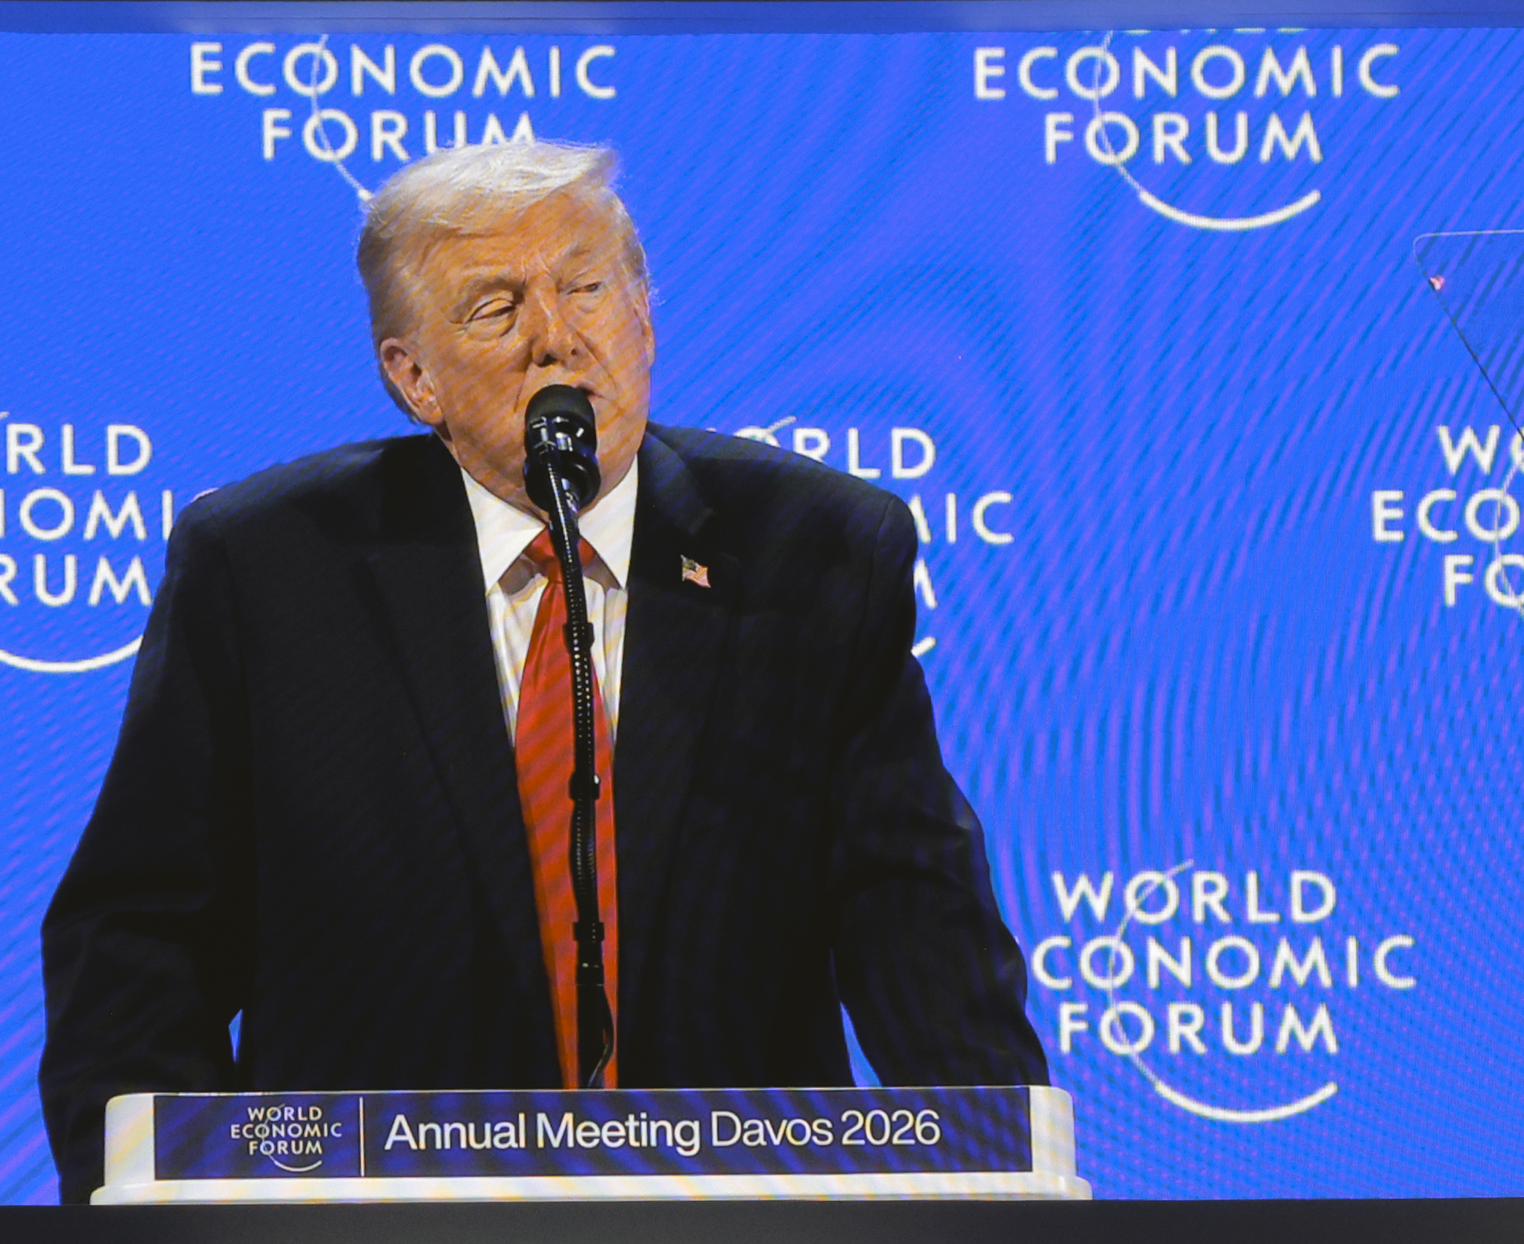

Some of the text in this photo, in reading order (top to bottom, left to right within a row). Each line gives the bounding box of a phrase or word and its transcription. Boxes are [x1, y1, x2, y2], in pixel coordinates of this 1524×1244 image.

[191, 42, 617, 98] ECONOMIC
[974, 43, 1399, 100] ECONOMIC
[1045, 111, 1323, 165] FORUM
[1052, 869, 1336, 924] WORLD
[1059, 1002, 1339, 1056] FORUM
[230, 1122, 342, 1139] ECONOMIC
[247, 1106, 323, 1121] WORLD
[384, 1109, 941, 1157] Annual Meeting Davos 2026
[248, 1140, 323, 1156] FORUM
